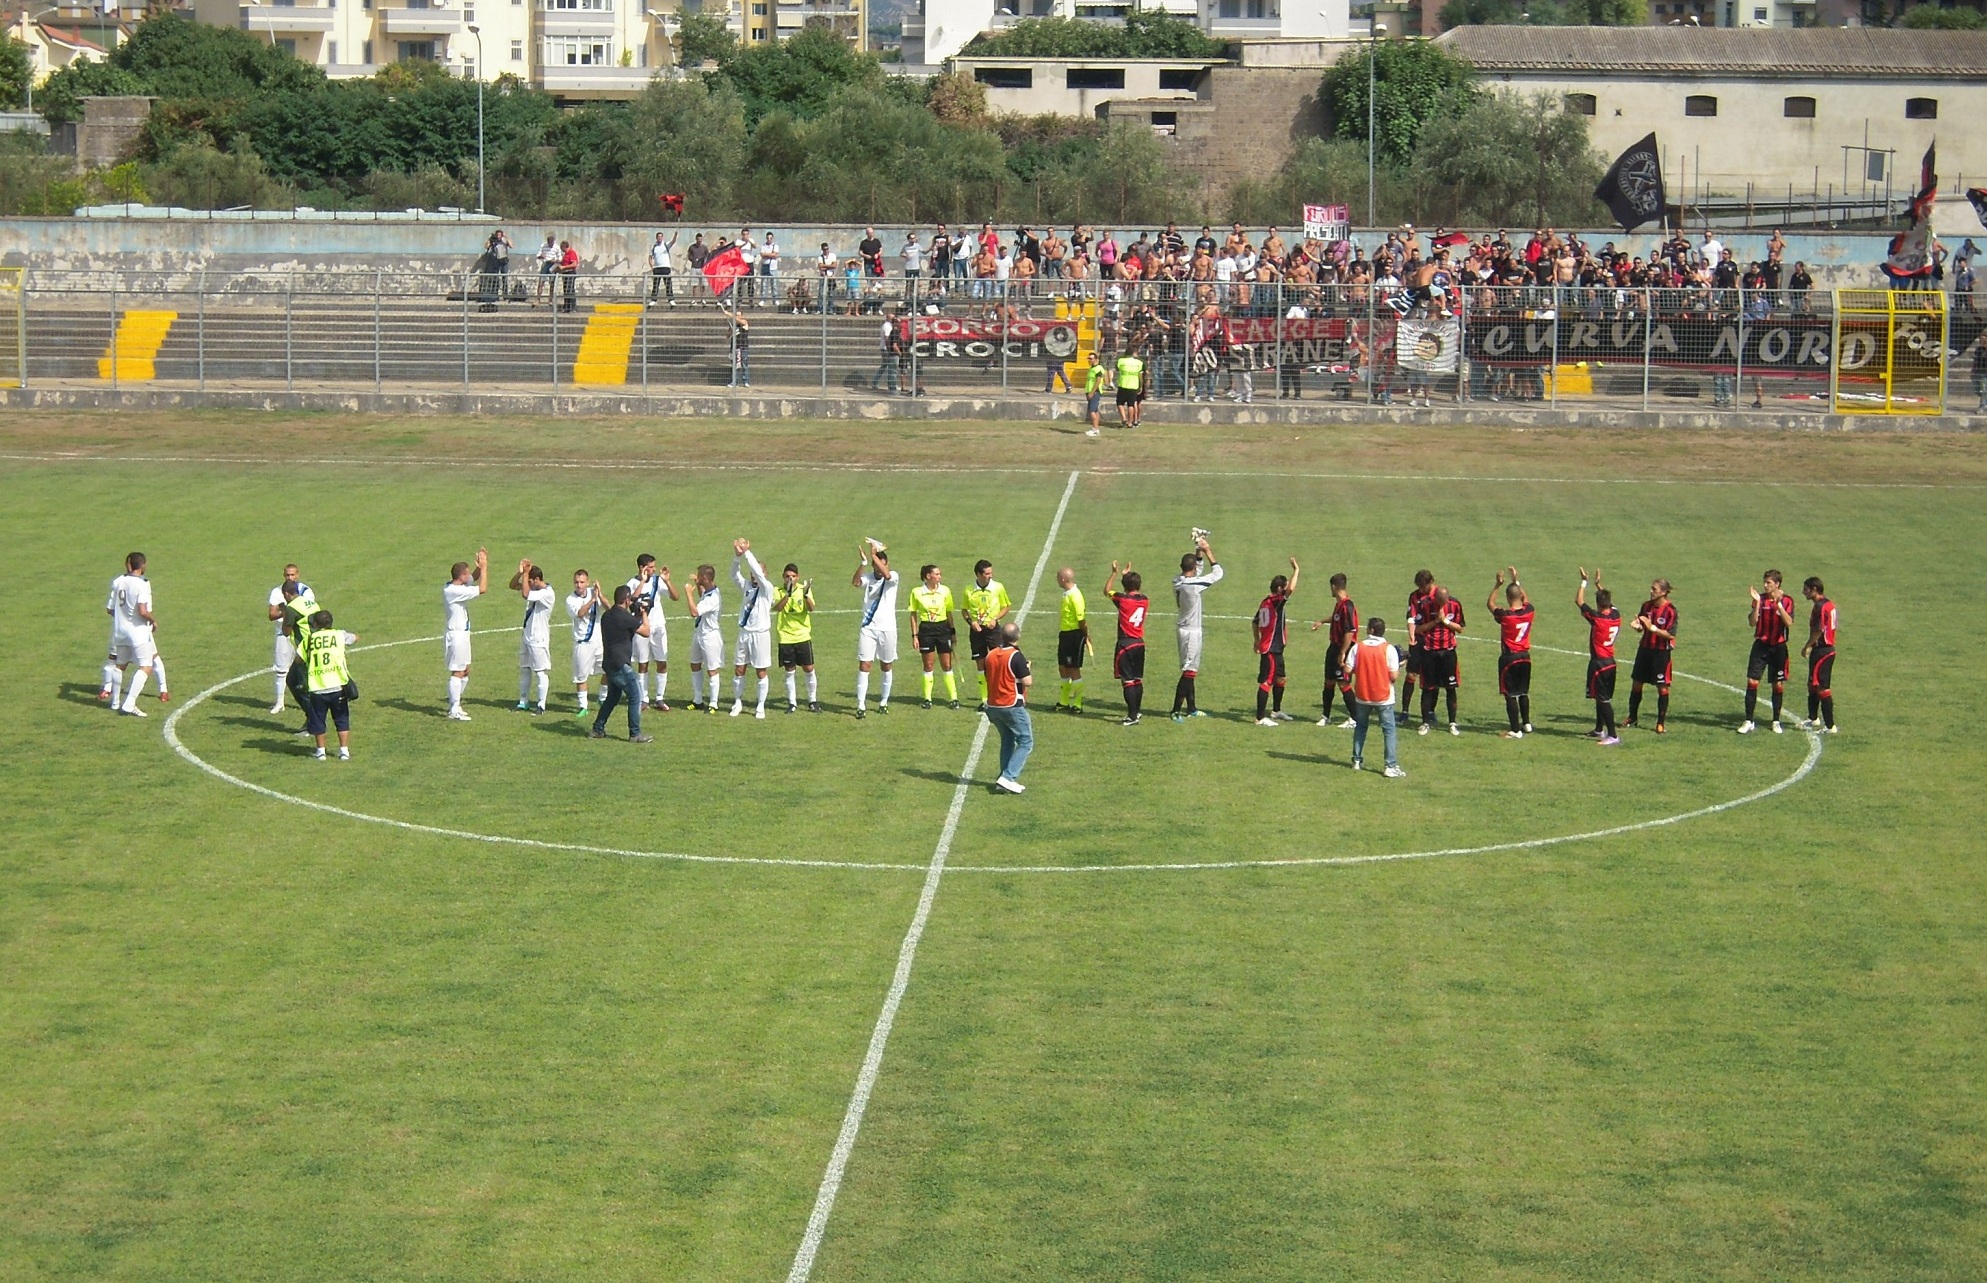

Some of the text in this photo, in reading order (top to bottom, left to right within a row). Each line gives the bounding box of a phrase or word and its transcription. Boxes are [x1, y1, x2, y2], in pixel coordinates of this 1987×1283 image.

[1482, 321, 1679, 356] CURVA
[1709, 325, 1876, 370] NORD
[909, 341, 1039, 358] CROCI
[118, 589, 127, 607] 9
[1128, 606, 1145, 627] 4
[1515, 621, 1531, 643] 7
[1603, 625, 1619, 647] 3
[313, 652, 330, 667] 18
